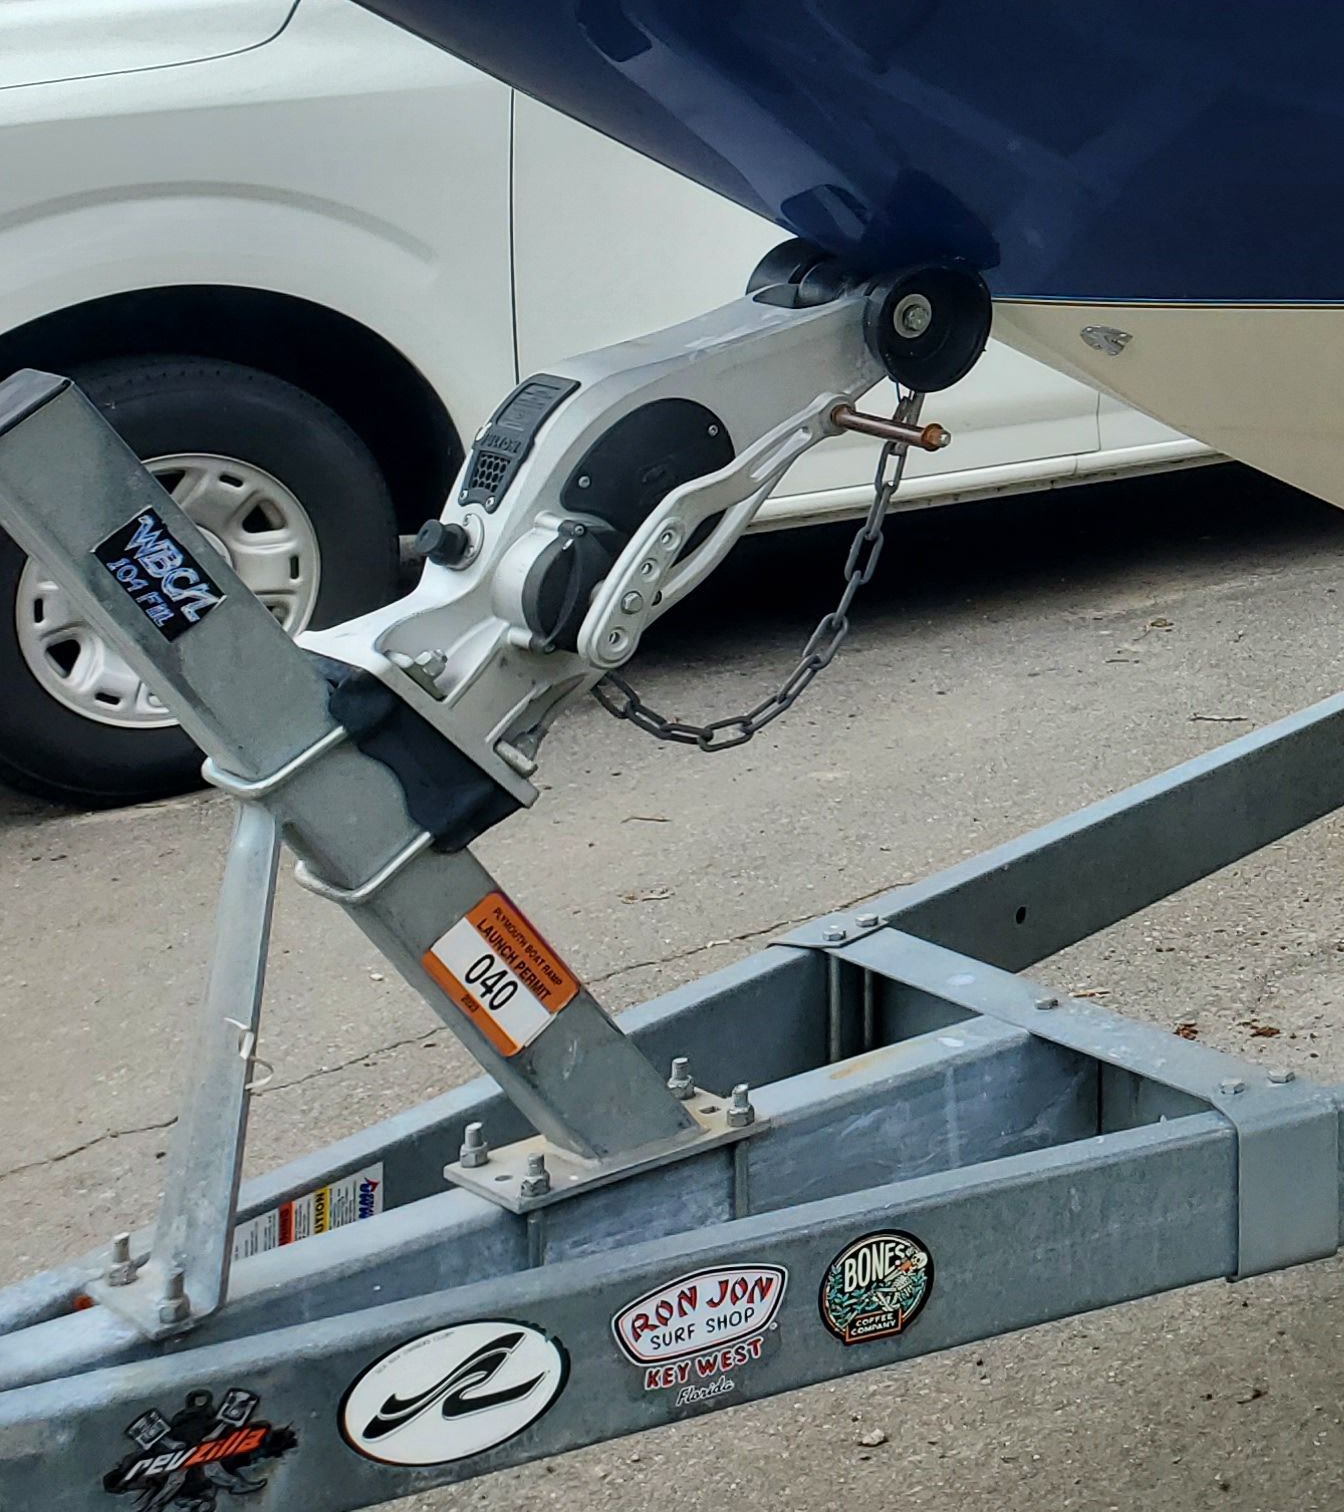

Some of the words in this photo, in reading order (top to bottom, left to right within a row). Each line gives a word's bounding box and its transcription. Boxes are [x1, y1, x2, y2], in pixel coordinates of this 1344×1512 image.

[106, 557, 149, 593] 104
[124, 514, 220, 623] WBCN
[476, 918, 520, 969] LAUNCH
[514, 960, 552, 1002] PERMIT
[492, 906, 527, 949] PLYMOUTH
[525, 945, 549, 968] BOAT
[464, 953, 519, 1011] 040
[314, 1191, 325, 1234] UTION
[844, 1241, 905, 1293] BONES
[630, 1285, 698, 1343] RON
[705, 1275, 774, 1309] JON
[650, 1323, 696, 1350] SURF
[705, 1306, 755, 1333] SHOP
[850, 1320, 896, 1336] COMPANY
[855, 1312, 894, 1327] COFFEE
[645, 1361, 691, 1390] KEY
[695, 1337, 763, 1377] WEST
[676, 1375, 735, 1406] Florida
